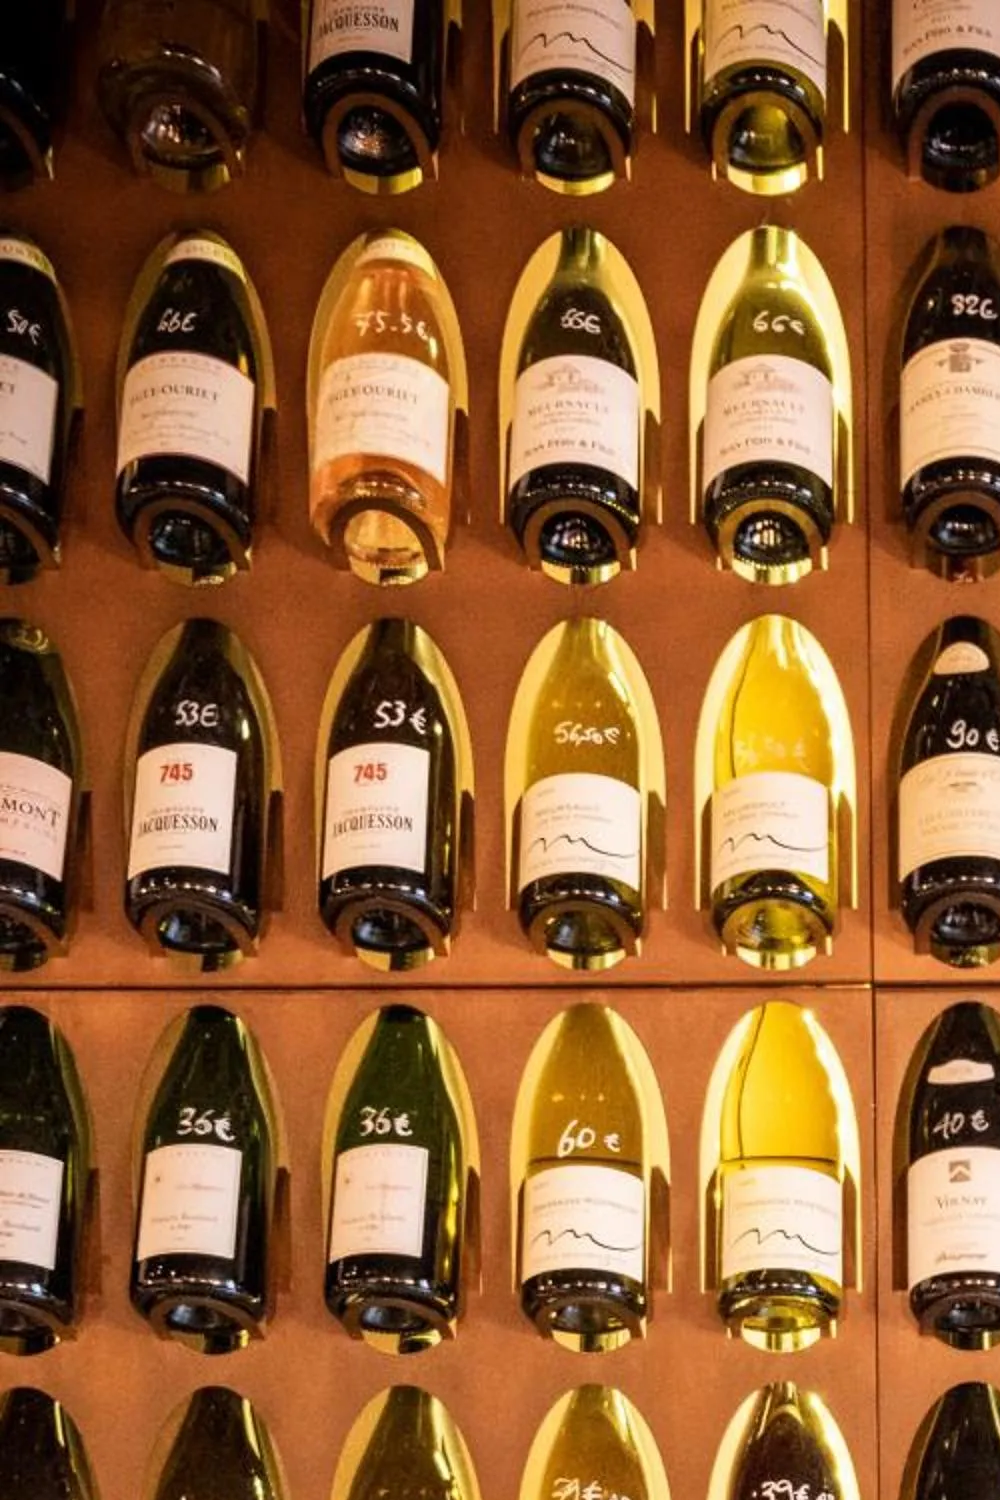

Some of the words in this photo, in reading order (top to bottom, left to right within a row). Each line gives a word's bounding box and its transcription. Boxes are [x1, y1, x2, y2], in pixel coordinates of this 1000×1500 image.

[160, 762, 194, 784] 745
[353, 762, 388, 783] 745
[137, 812, 219, 839] JACQUESSON
[332, 812, 414, 839] JACQUESSON
